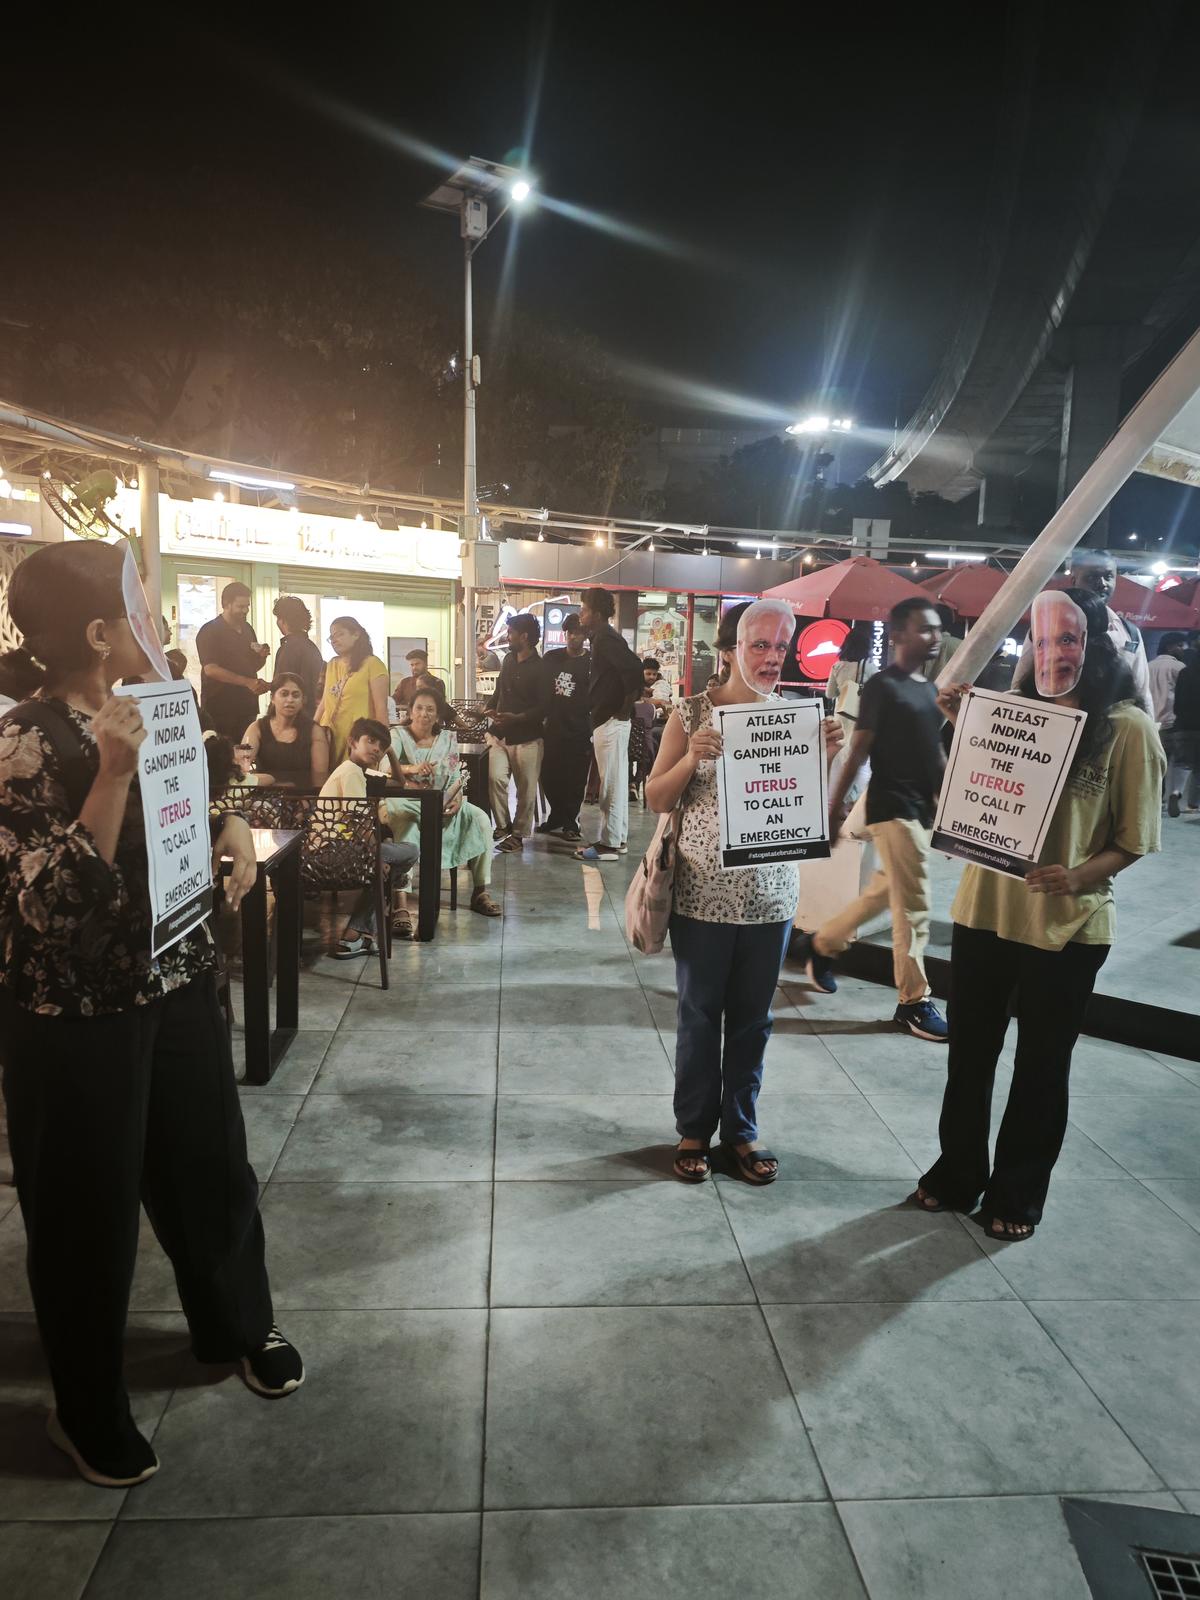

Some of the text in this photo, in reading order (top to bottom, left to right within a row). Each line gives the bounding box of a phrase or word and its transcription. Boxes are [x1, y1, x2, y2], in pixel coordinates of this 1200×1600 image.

[558, 671, 573, 682] AIR
[152, 700, 189, 721] ATLEAST
[746, 713, 796, 727] ATLEAST
[991, 707, 1049, 728] ATLEAST
[154, 725, 186, 746] INDIRA
[751, 730, 792, 743] INDIRA
[991, 723, 1036, 743] INDIRA
[733, 744, 809, 760] GANDHI HAD
[969, 736, 1051, 764] GANDHI HAD
[144, 746, 196, 775] GANDHI HAD
[760, 762, 781, 774] THE
[990, 758, 1014, 773] THE
[164, 776, 180, 795] THE
[745, 777, 797, 794] UTERUS
[970, 770, 1025, 796] UTERUS
[744, 795, 804, 811] TO CALL IT
[964, 789, 1026, 816] TO CALL IT
[159, 798, 192, 828] UTERUS
[766, 813, 783, 825] AN
[979, 812, 998, 826] AN
[162, 824, 197, 855] TO CALL IT
[740, 827, 811, 843] EMERGENCY
[951, 820, 1021, 851] EMERGENCY
[179, 854, 190, 874] AN
[165, 870, 204, 908] EMERGENCY
